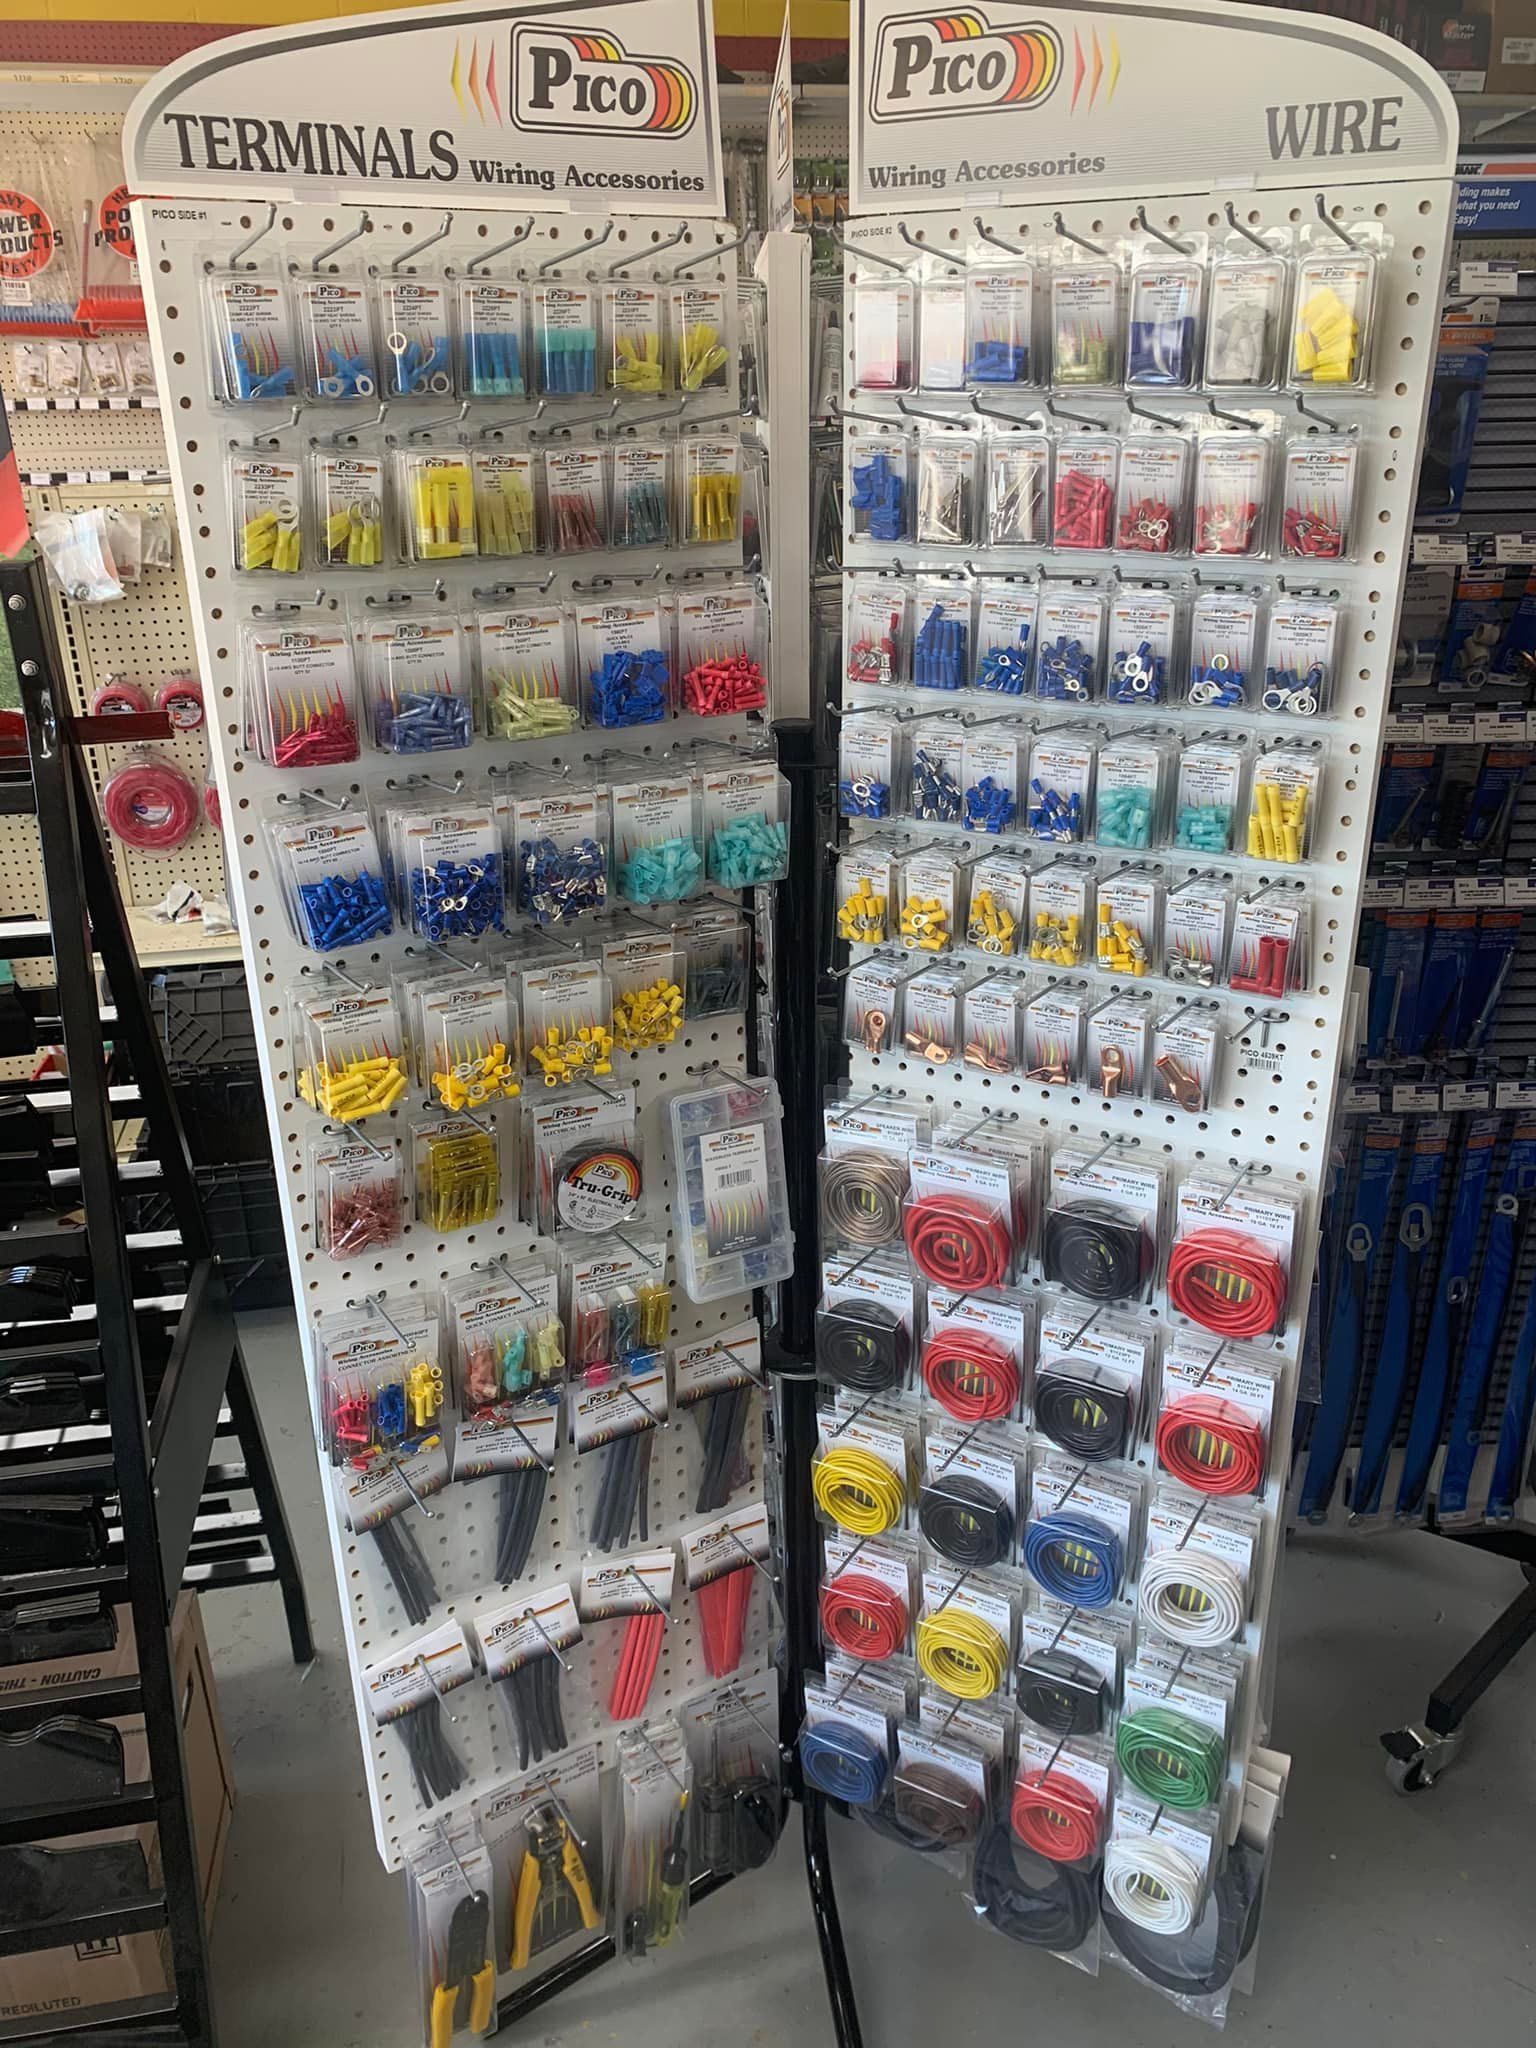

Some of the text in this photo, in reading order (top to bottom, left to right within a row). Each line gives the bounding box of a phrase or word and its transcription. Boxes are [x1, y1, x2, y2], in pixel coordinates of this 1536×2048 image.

[1267, 97, 1403, 160] WIRE
[163, 113, 460, 182] TERMINALS
[469, 159, 704, 193] Wiring Accessories
[869, 153, 1106, 190] Wiring Accessories
[1481, 187, 1511, 197] makes
[152, 210, 175, 219] PICO
[178, 210, 196, 220] SIDE
[1479, 202, 1495, 212] you
[1497, 200, 1520, 210] need
[40, 1667, 101, 1686] CAUTION
